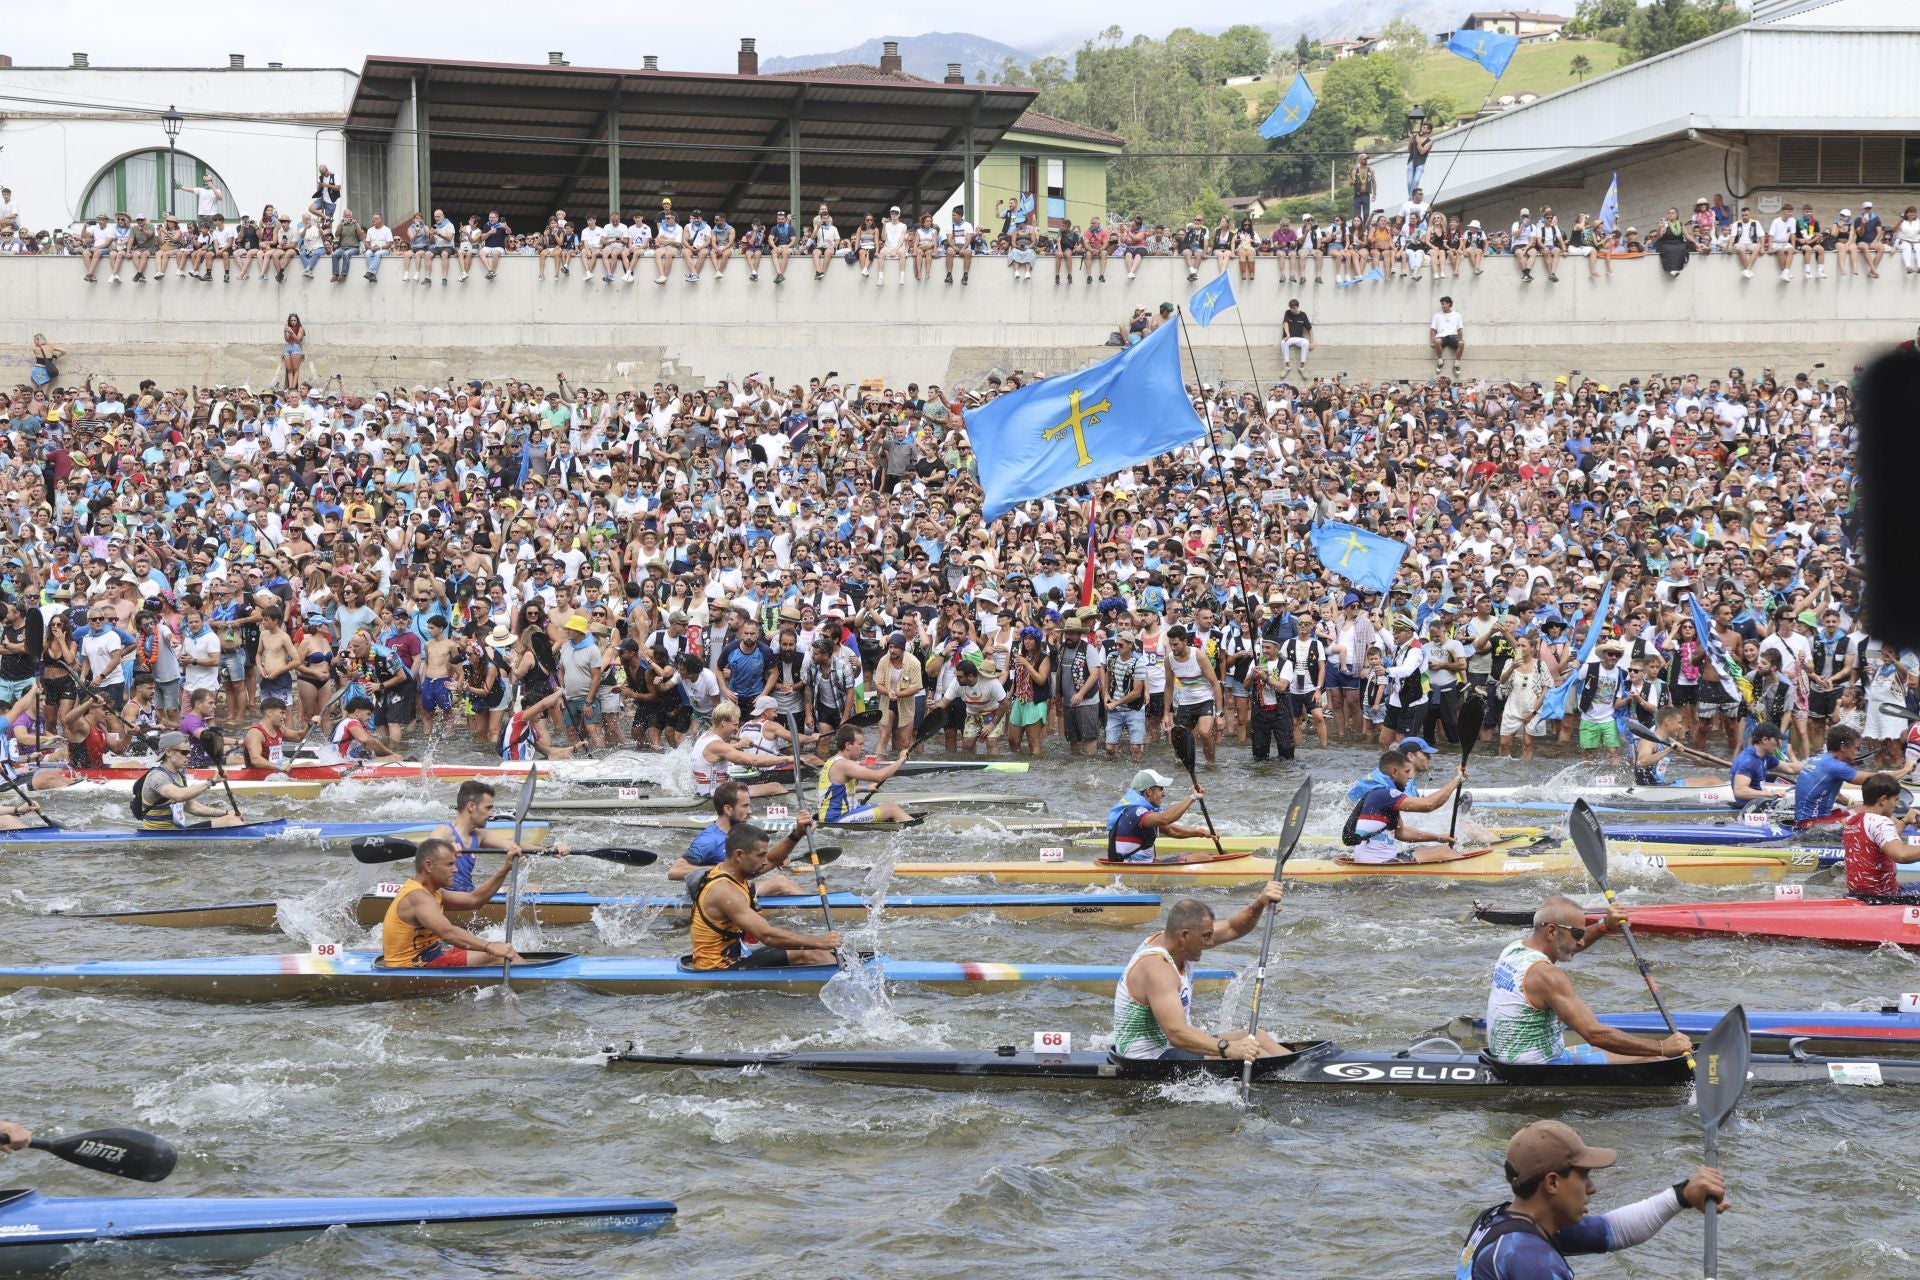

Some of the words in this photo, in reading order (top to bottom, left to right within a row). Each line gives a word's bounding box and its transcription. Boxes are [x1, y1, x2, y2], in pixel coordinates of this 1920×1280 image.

[1042, 849, 1062, 857] 239
[380, 884, 401, 893] 102
[1780, 885, 1801, 895] 139
[318, 944, 335, 955] 98
[1910, 994, 1920, 1006] 7
[1042, 1033, 1062, 1046] 68
[1389, 1066, 1476, 1080] ELIO
